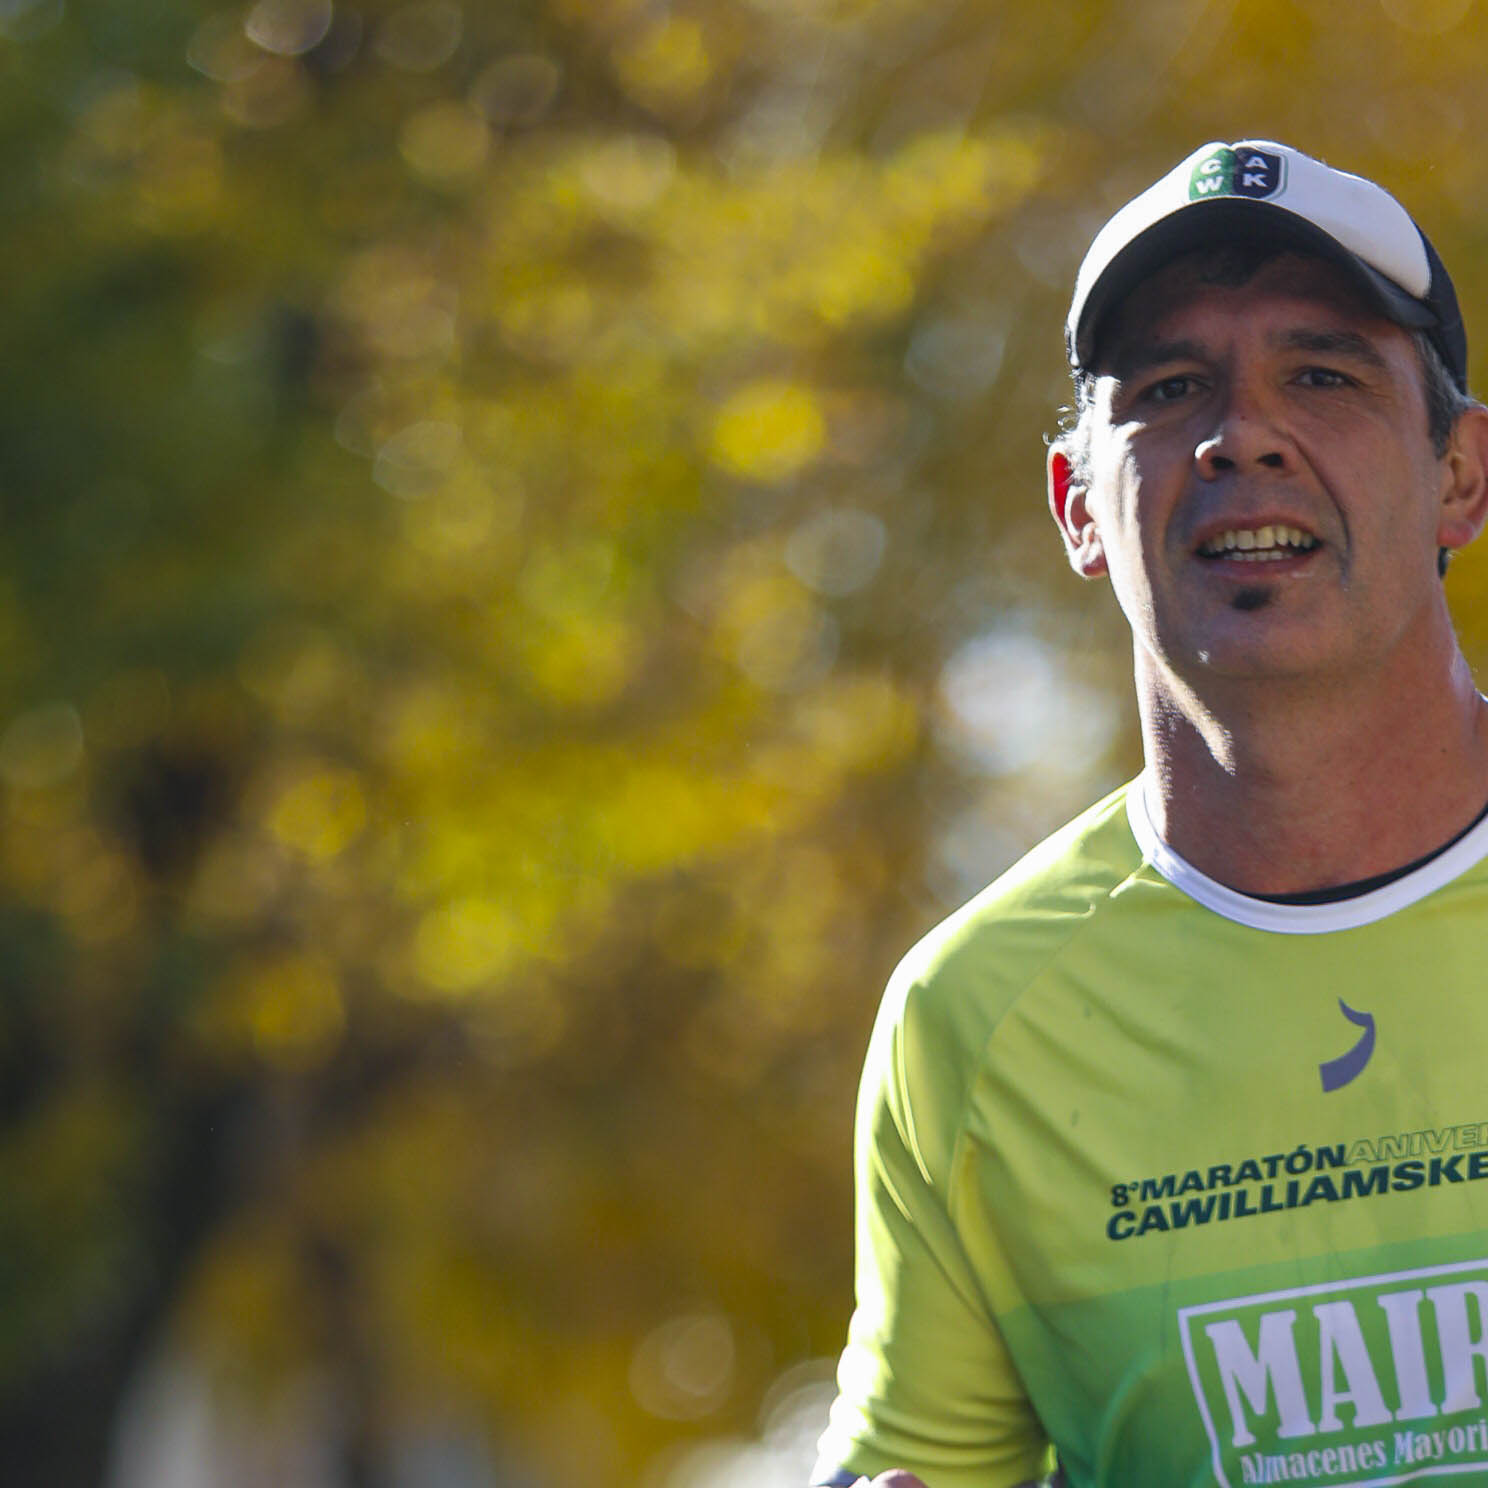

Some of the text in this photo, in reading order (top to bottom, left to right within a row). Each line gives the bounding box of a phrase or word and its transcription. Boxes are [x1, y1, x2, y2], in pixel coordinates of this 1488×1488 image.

[1244, 156, 1270, 170] A
[1195, 172, 1268, 194] W K
[1239, 1438, 1387, 1485] Almacenes
